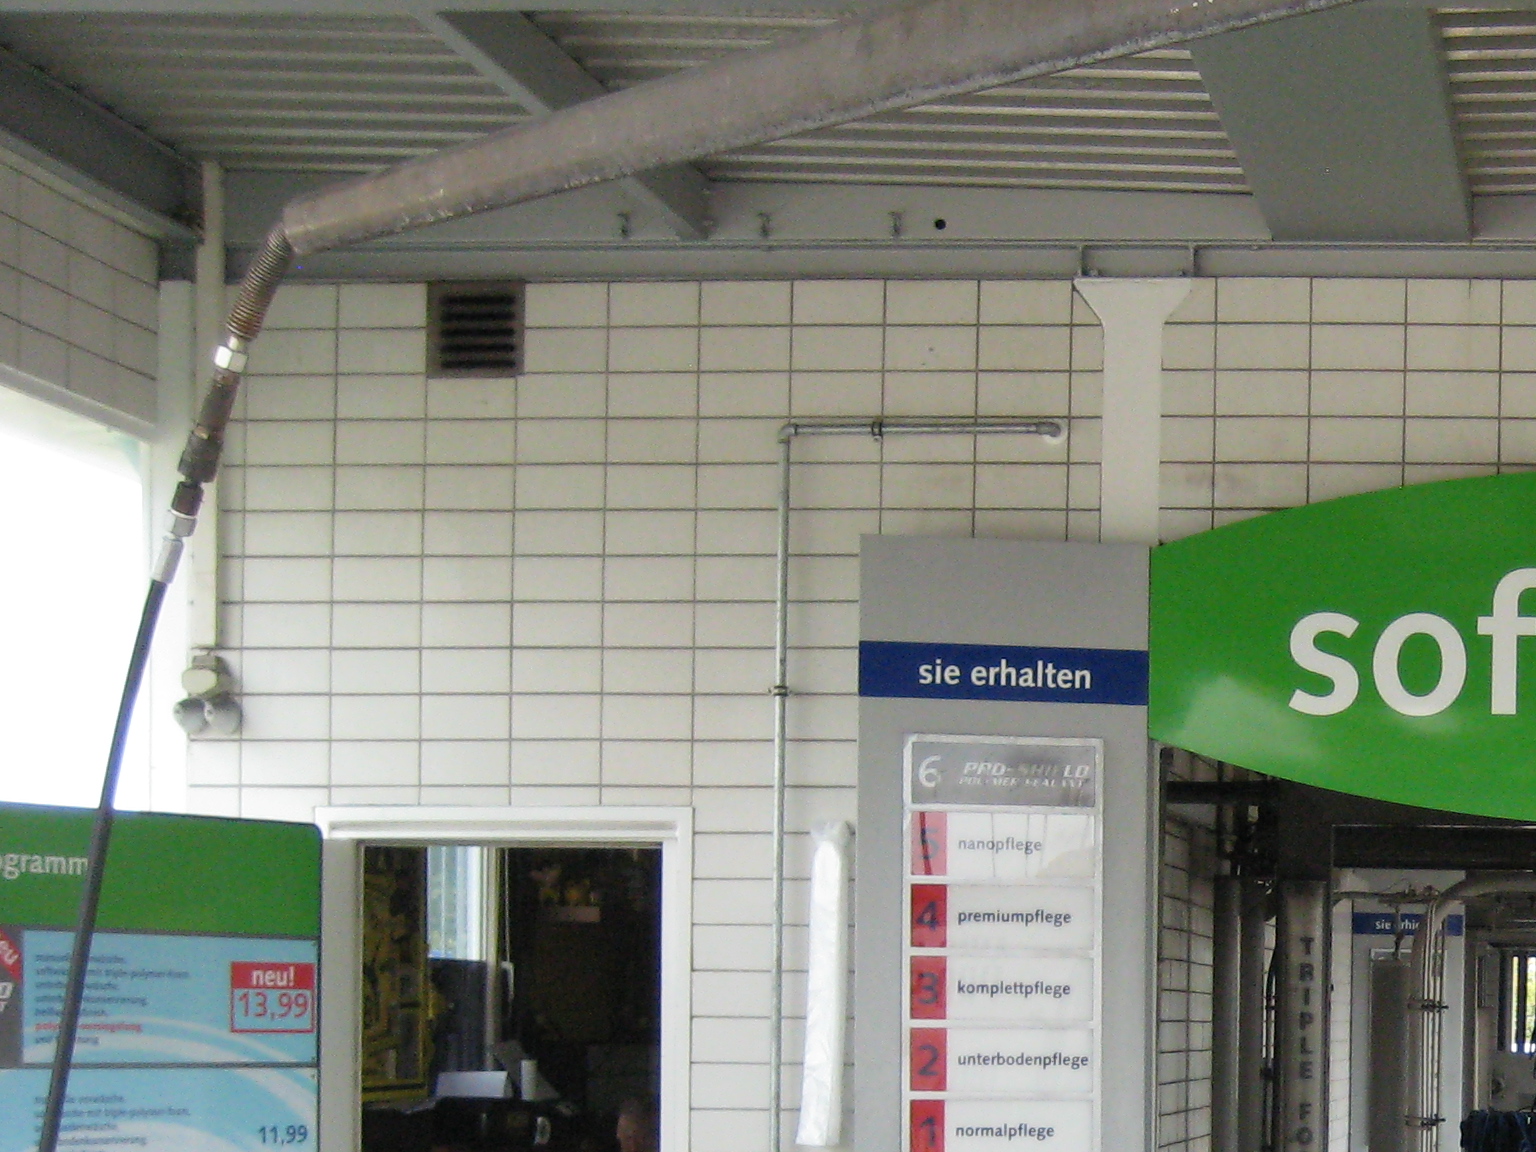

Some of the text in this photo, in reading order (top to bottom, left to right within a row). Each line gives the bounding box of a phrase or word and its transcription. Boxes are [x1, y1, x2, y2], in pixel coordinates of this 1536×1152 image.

[918, 658, 1091, 689] sie erhalten
[918, 755, 942, 788] 6
[919, 827, 1043, 861] 5 nanopflege
[0, 853, 89, 880] gramm
[916, 900, 1072, 931] 4 premiumpflege
[1375, 919, 1392, 930] sie
[251, 967, 296, 988] neu!
[916, 970, 1071, 1006] 3 komplettpflege
[237, 990, 310, 1021] 13,99
[1299, 937, 1315, 1080] TRIPLE
[917, 1044, 1090, 1077] 2 unterbodenpflege
[258, 1125, 309, 1144] 11,99
[919, 1116, 1055, 1149] 1 normalpflege
